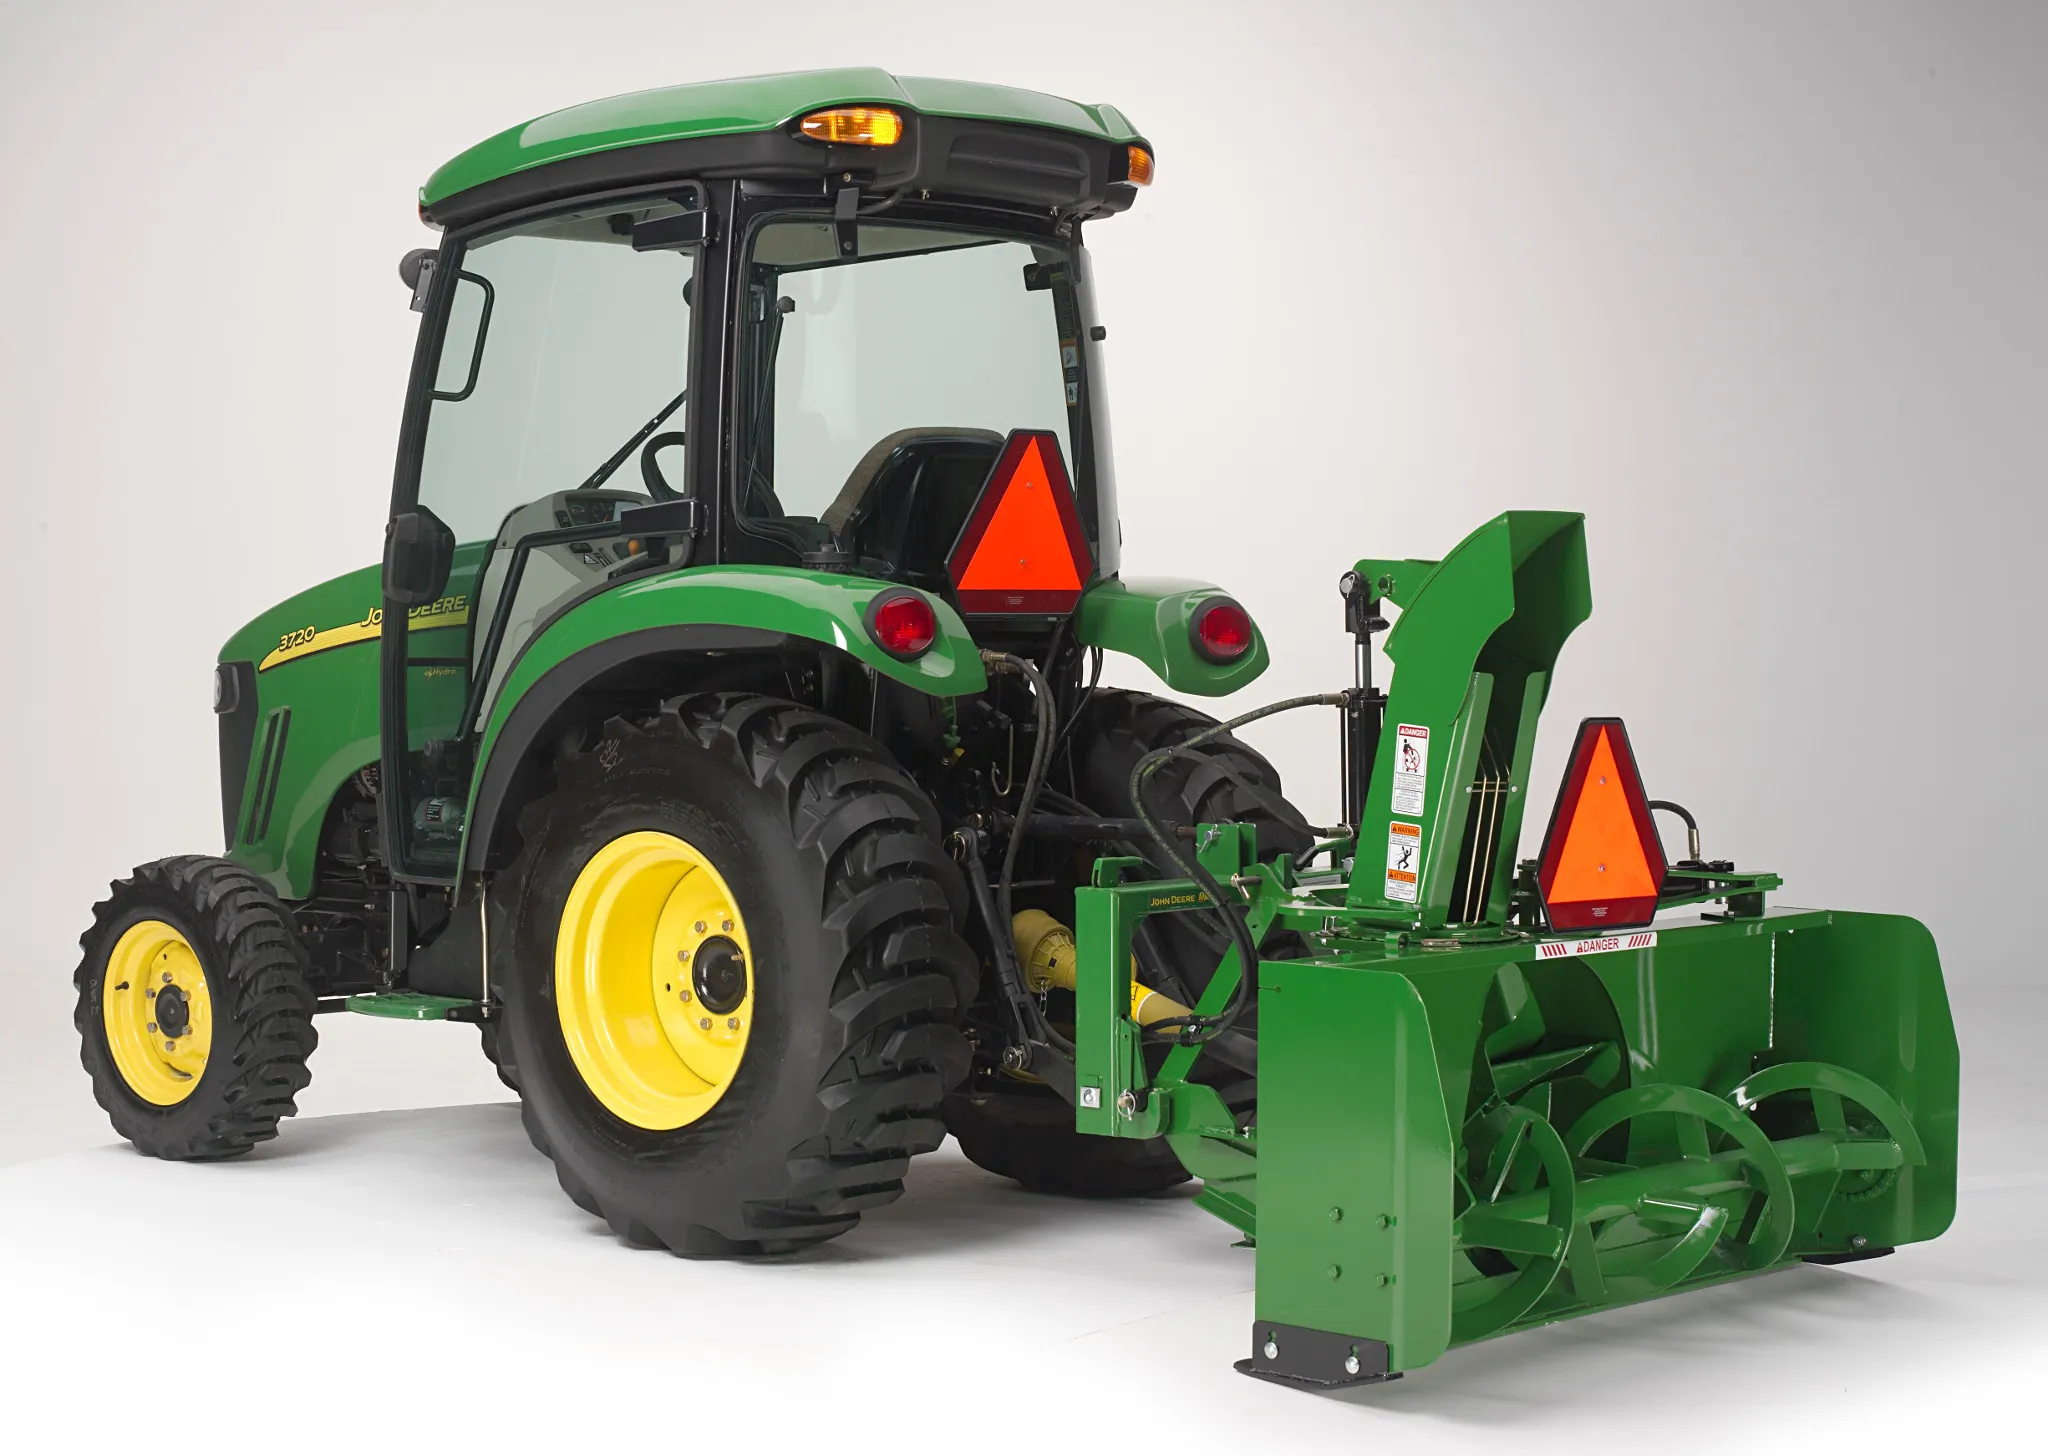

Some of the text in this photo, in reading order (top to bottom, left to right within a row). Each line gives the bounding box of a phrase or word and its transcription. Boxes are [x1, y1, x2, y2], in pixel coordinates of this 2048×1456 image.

[279, 626, 316, 651] 3720
[1405, 728, 1427, 737] DANGER
[1397, 826, 1420, 835] WARNING
[1393, 872, 1416, 881] ATTENTION
[1151, 895, 1170, 906] JOHN
[1171, 894, 1195, 904] DEERE
[1583, 938, 1619, 953] DANGER
